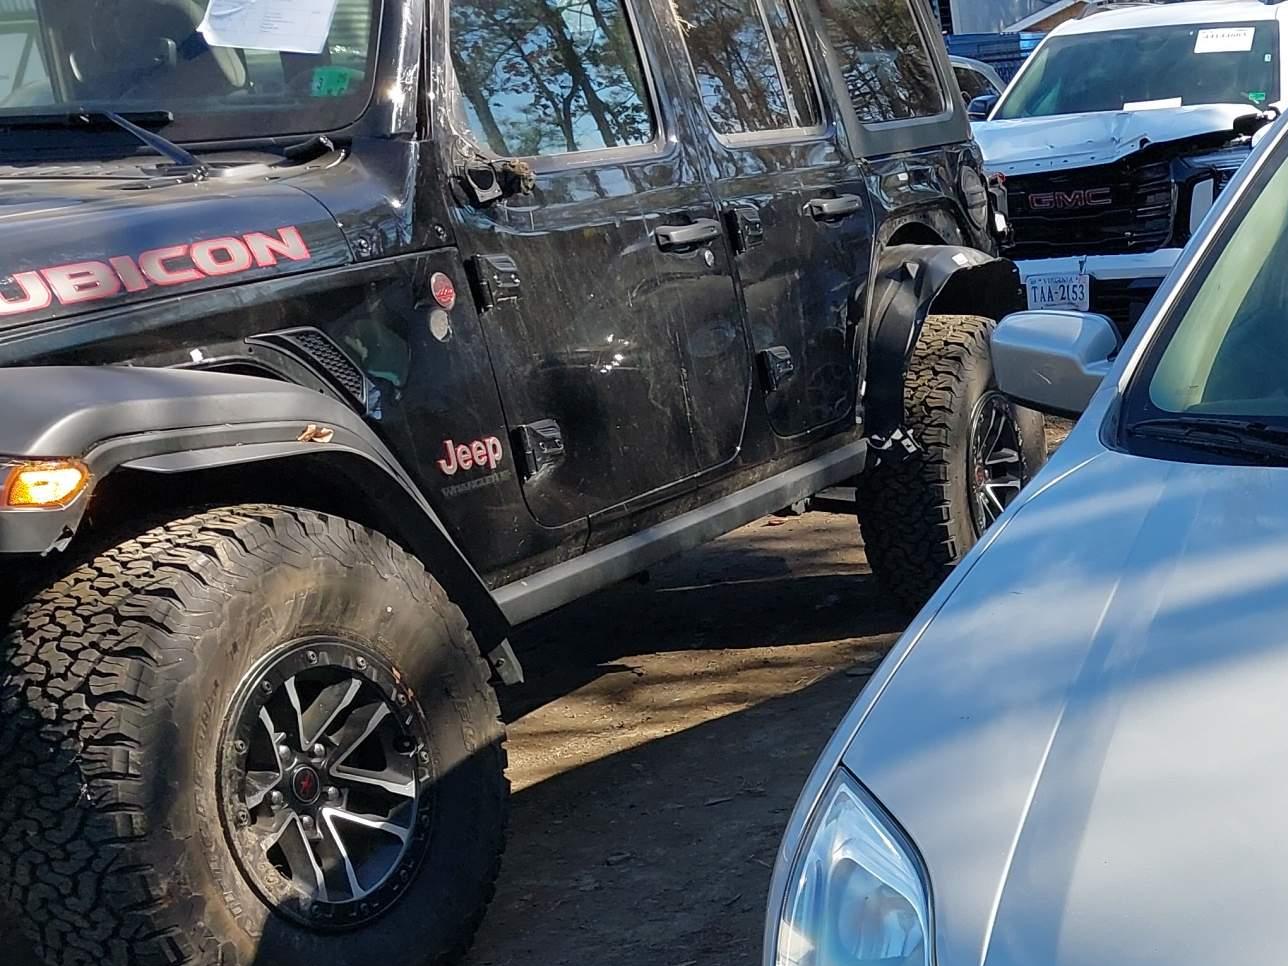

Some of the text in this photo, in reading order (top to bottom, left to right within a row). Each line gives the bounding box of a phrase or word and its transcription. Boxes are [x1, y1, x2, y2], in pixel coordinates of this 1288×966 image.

[1028, 187, 1113, 210] GMC
[1031, 284, 1085, 303] TAA-2153
[436, 435, 503, 476] Jeep
